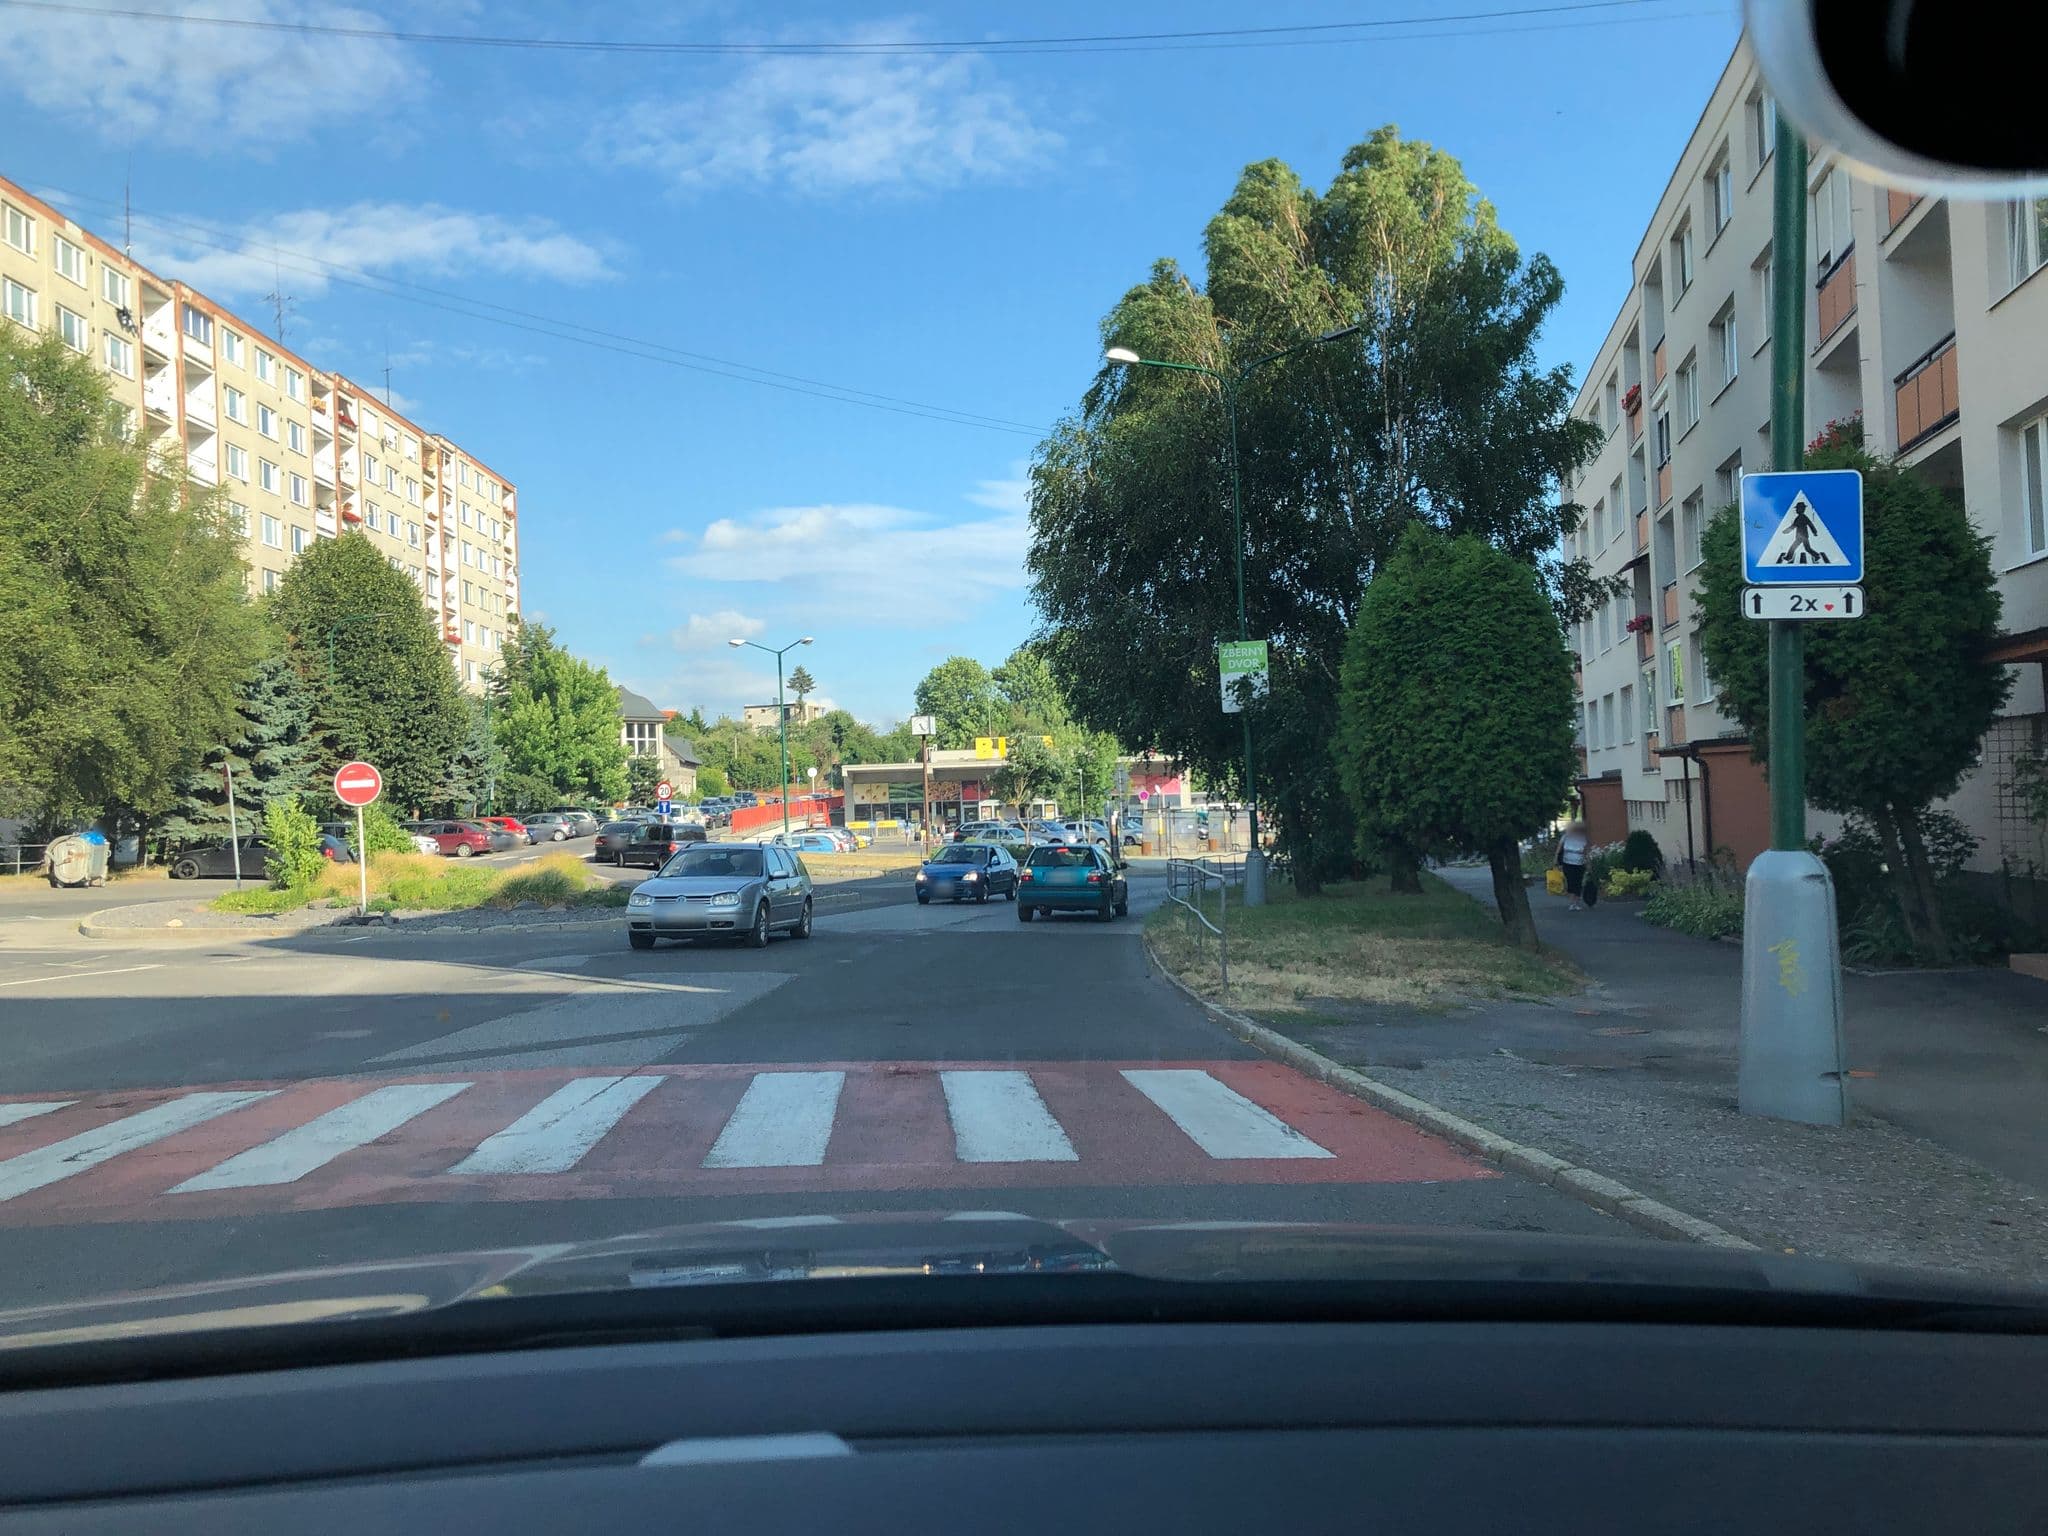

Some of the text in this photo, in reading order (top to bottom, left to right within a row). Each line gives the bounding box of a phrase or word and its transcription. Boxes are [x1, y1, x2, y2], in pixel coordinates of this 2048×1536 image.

[1789, 594, 1818, 612] 2x
[1228, 658, 1260, 669] DVOR
[659, 787, 669, 796] 20
